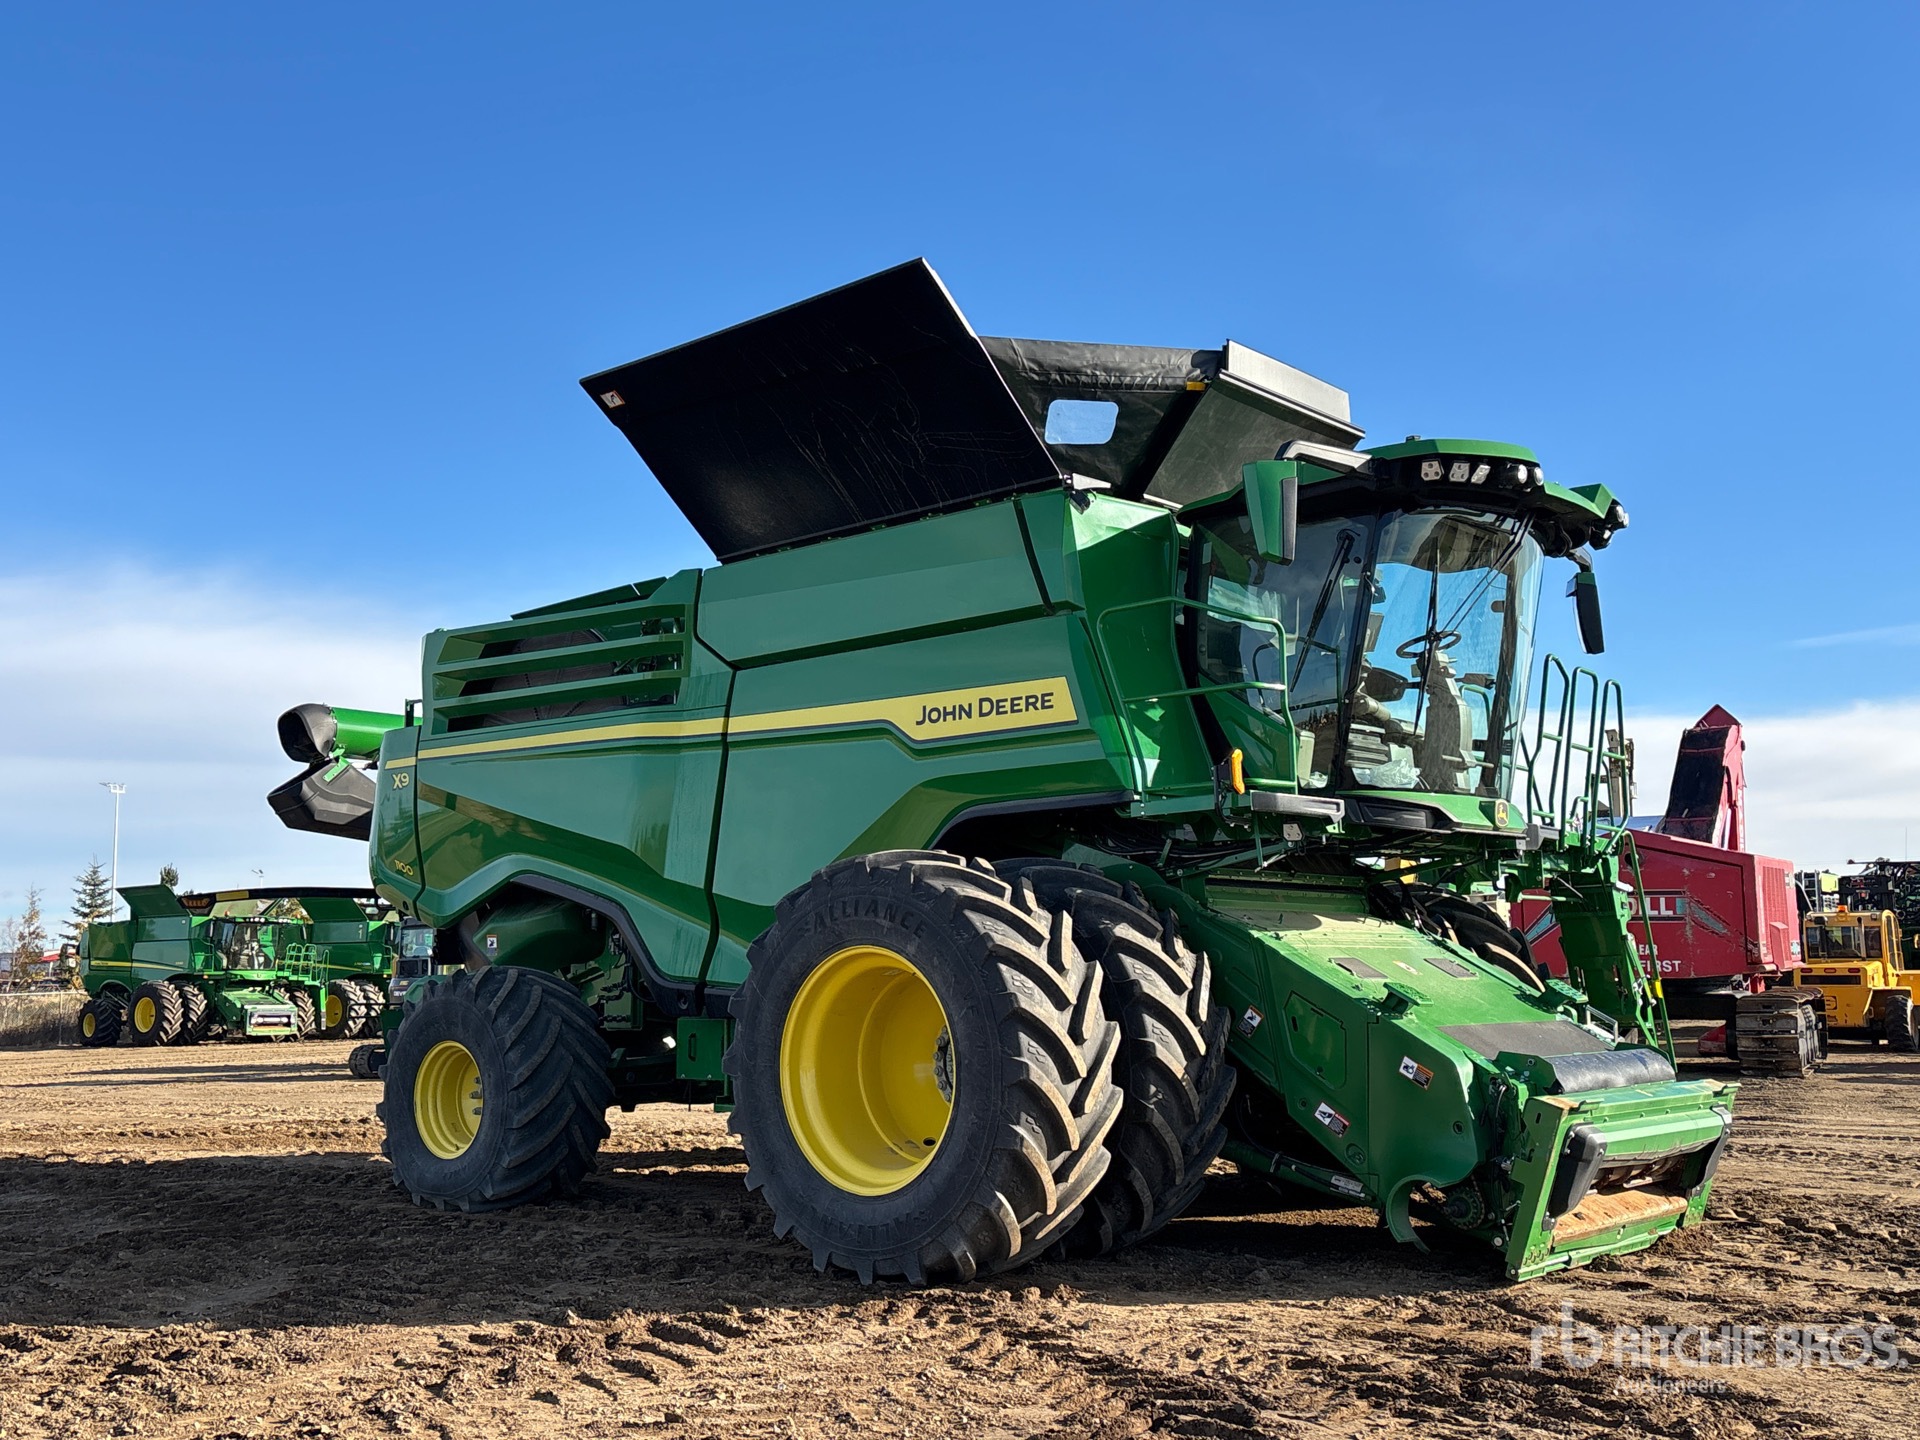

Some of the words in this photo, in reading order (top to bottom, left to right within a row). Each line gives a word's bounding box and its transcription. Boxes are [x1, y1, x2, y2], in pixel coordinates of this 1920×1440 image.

[916, 703, 972, 726] JOHN
[978, 692, 1054, 718] DEERE
[392, 772, 410, 789] X9
[394, 859, 414, 876] 1100
[813, 898, 928, 939] ALLIANCE
